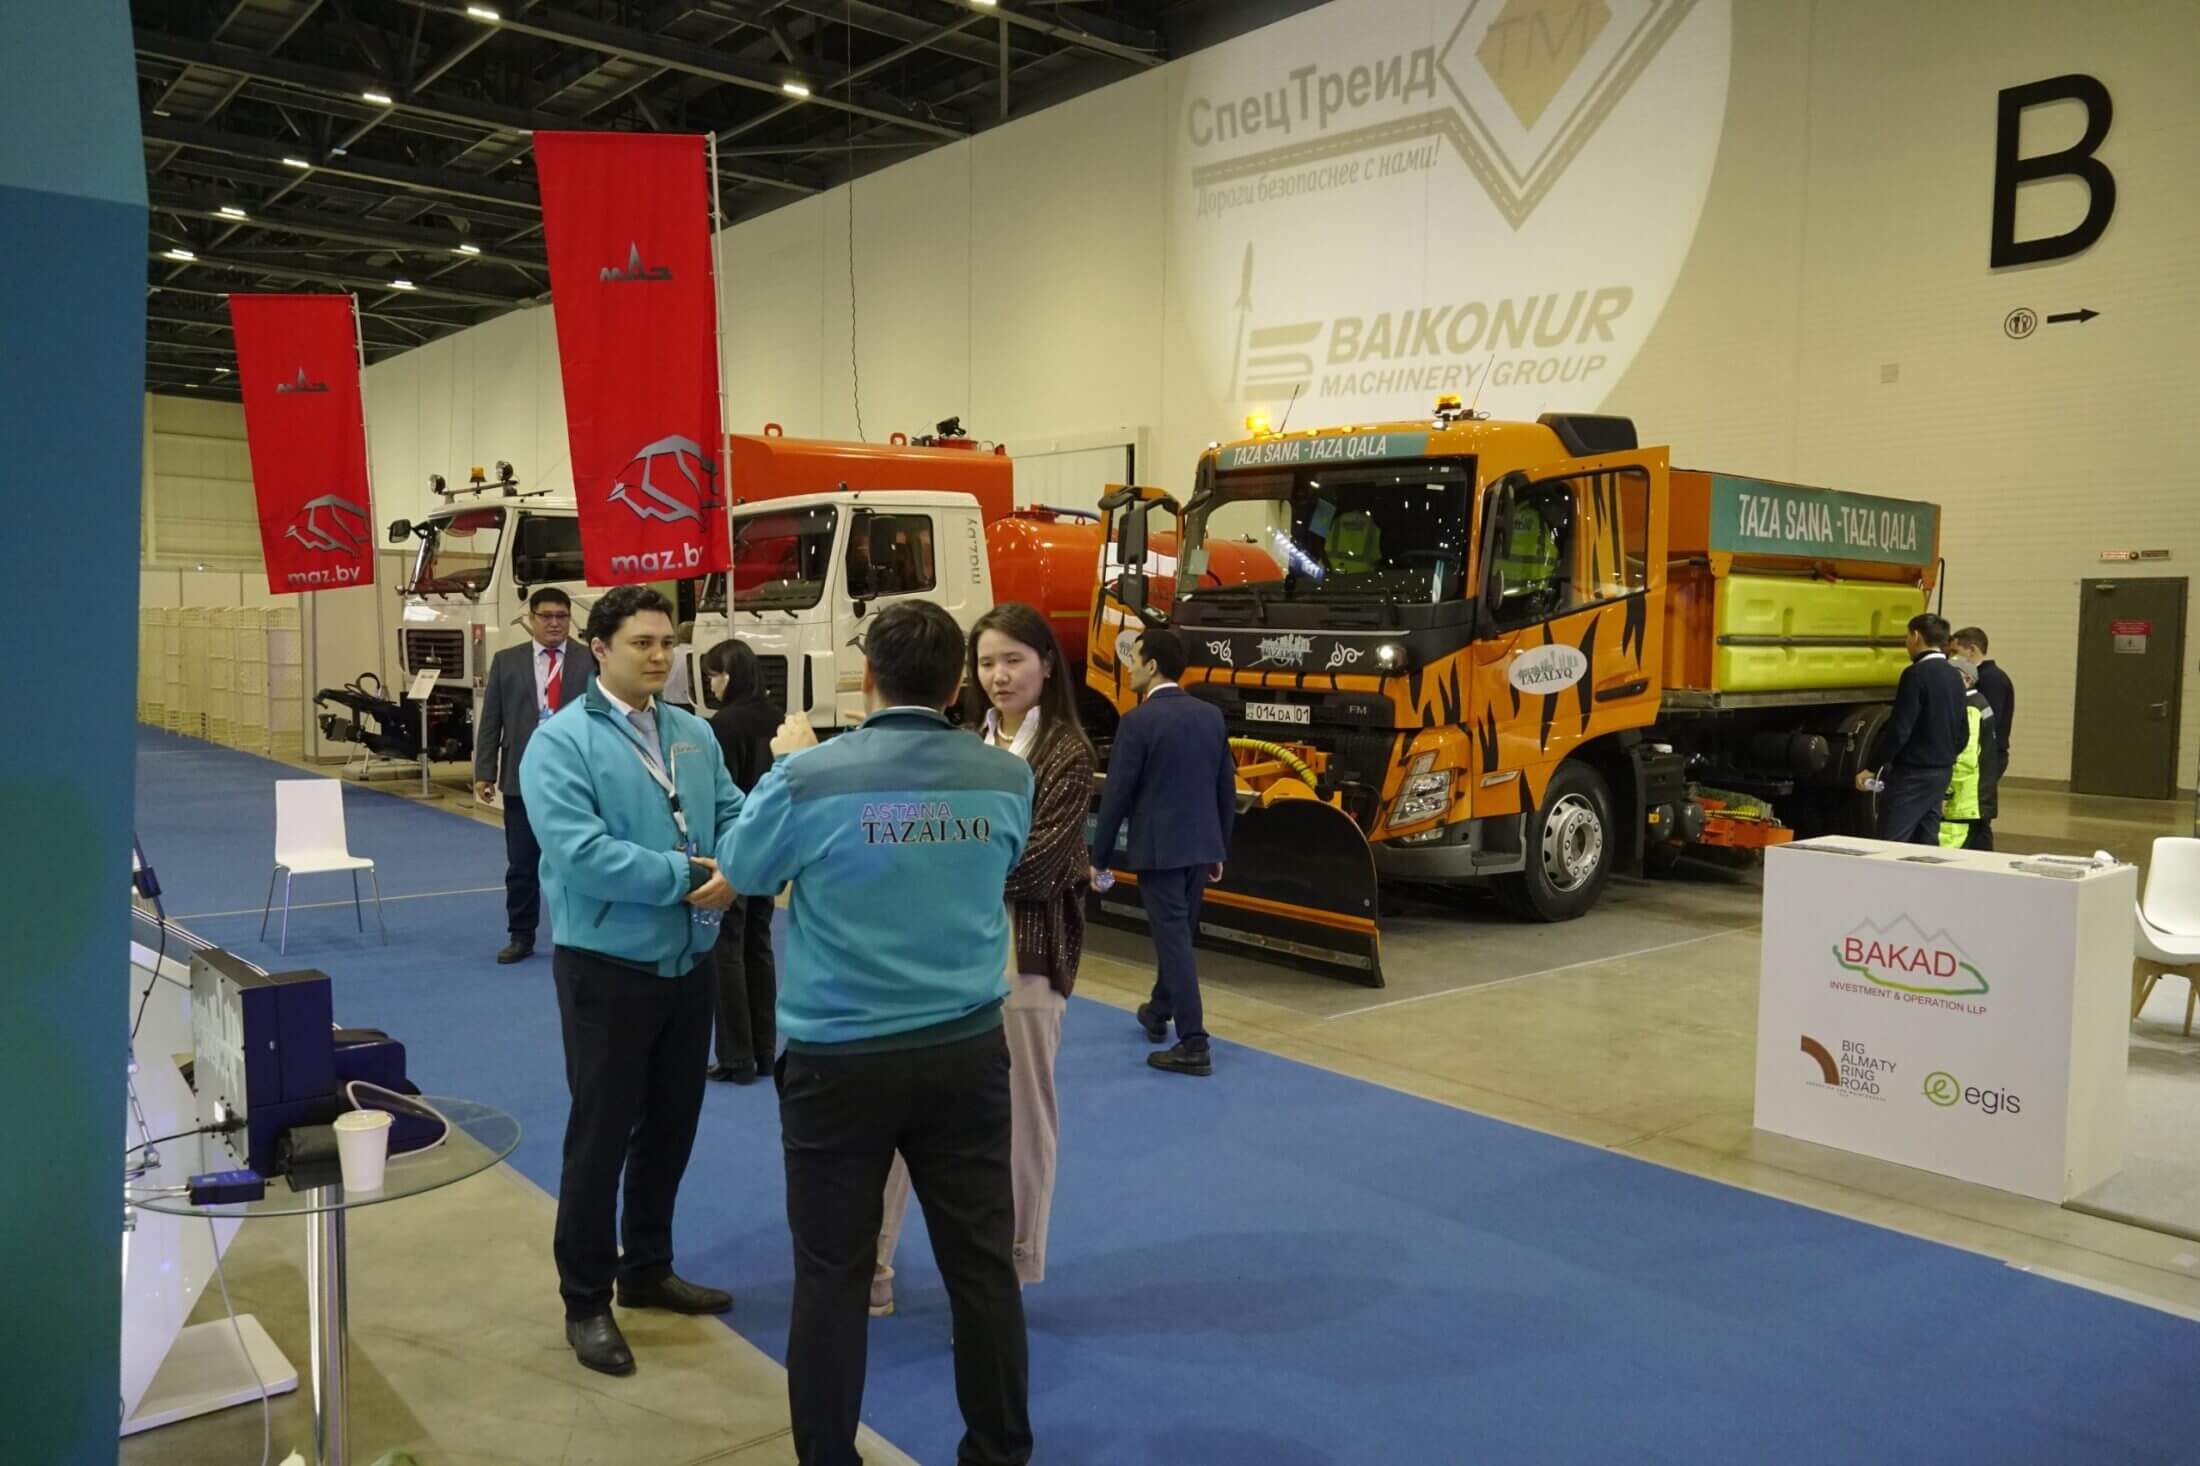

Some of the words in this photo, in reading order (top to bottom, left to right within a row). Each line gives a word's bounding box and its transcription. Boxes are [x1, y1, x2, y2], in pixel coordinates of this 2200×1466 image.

[1257, 162, 1360, 203] безопаснее
[1378, 136, 1441, 178] нами!
[1326, 285, 1633, 366] BAIKONUR
[1320, 363, 1483, 398] MACHINERY
[1491, 355, 1607, 388] GROUP
[1233, 446, 1261, 466] TAZA
[1264, 441, 1300, 463] SANA
[1347, 435, 1387, 459] QALA
[1739, 494, 1780, 539] TAZA
[1785, 500, 1833, 543] SANA
[1880, 512, 1917, 552] QALA
[611, 542, 703, 576] maz.b
[288, 565, 360, 585] maz.by
[1520, 667, 1573, 685] TAZALYQ
[1256, 705, 1276, 720] 014
[862, 802, 951, 821] ASTANA
[862, 817, 991, 844] TAZALYQ
[1845, 937, 1957, 977] BAKAD
[1829, 980, 1892, 1000] INVESTMENT
[1894, 992, 1901, 1001] &
[1903, 994, 1964, 1013] OPERATION
[1967, 1004, 1987, 1015] LLP
[1842, 1040, 1865, 1055] BIG
[1841, 1053, 1896, 1073] ALMATY
[1841, 1065, 1875, 1082] RING
[1841, 1077, 1880, 1095] ROAD
[1965, 1087, 2020, 1114] egis
